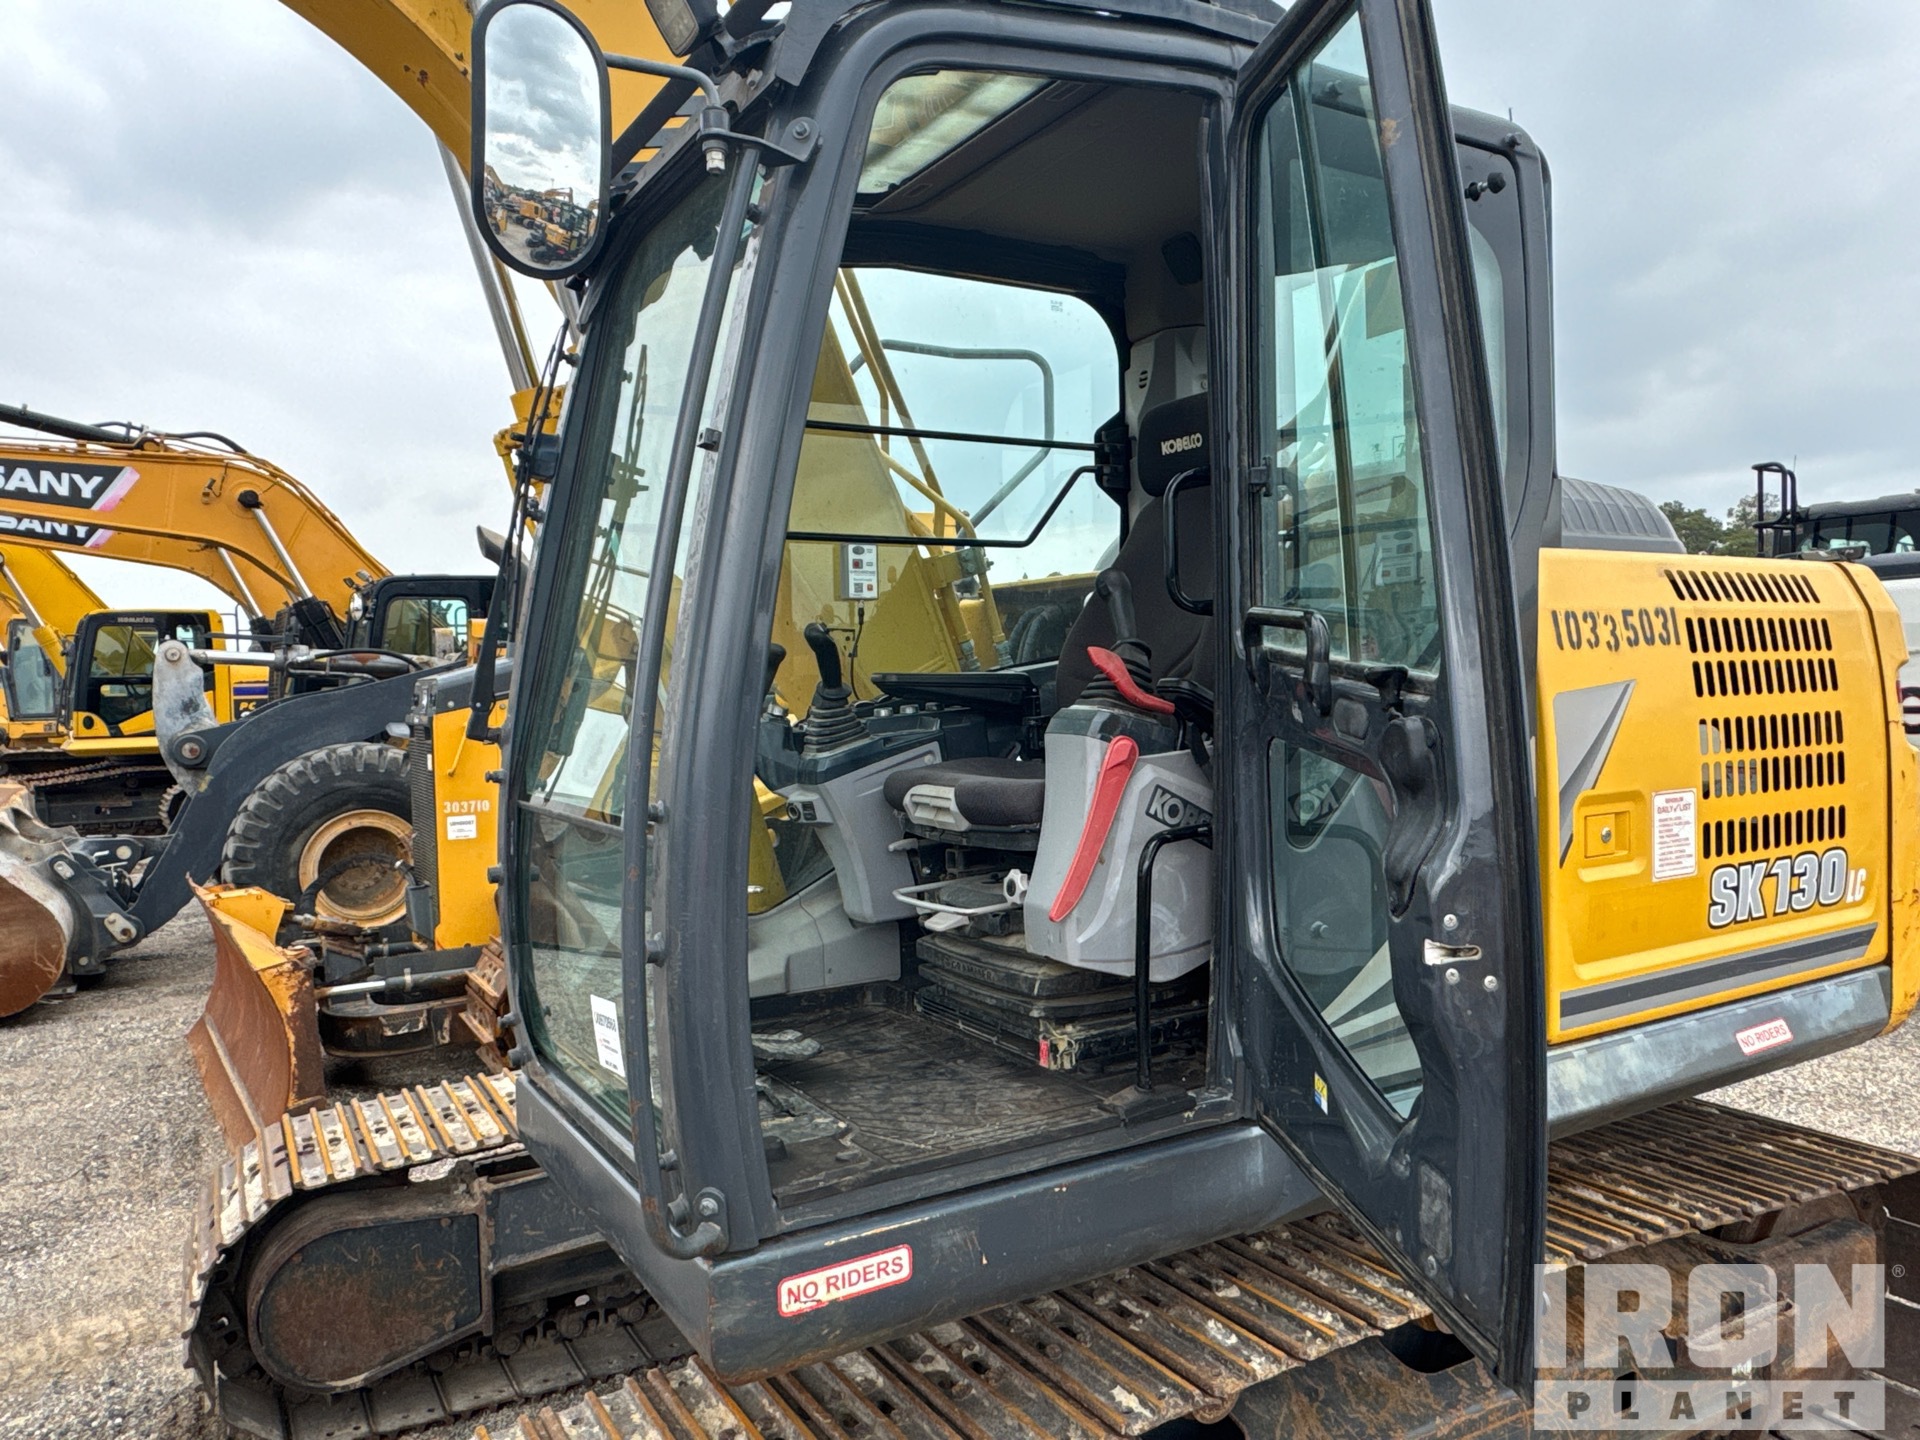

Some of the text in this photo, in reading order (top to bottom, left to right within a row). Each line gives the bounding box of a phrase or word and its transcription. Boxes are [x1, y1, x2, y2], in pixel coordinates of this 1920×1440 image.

[1160, 432, 1203, 456] KOBELCO
[0, 466, 104, 499] ANY
[1551, 606, 1681, 652] 10335031
[443, 799, 490, 814] 303710
[1845, 868, 1867, 904] LC
[1740, 1024, 1788, 1048] NO RIDERS
[786, 1256, 904, 1306] NO RIDERS
